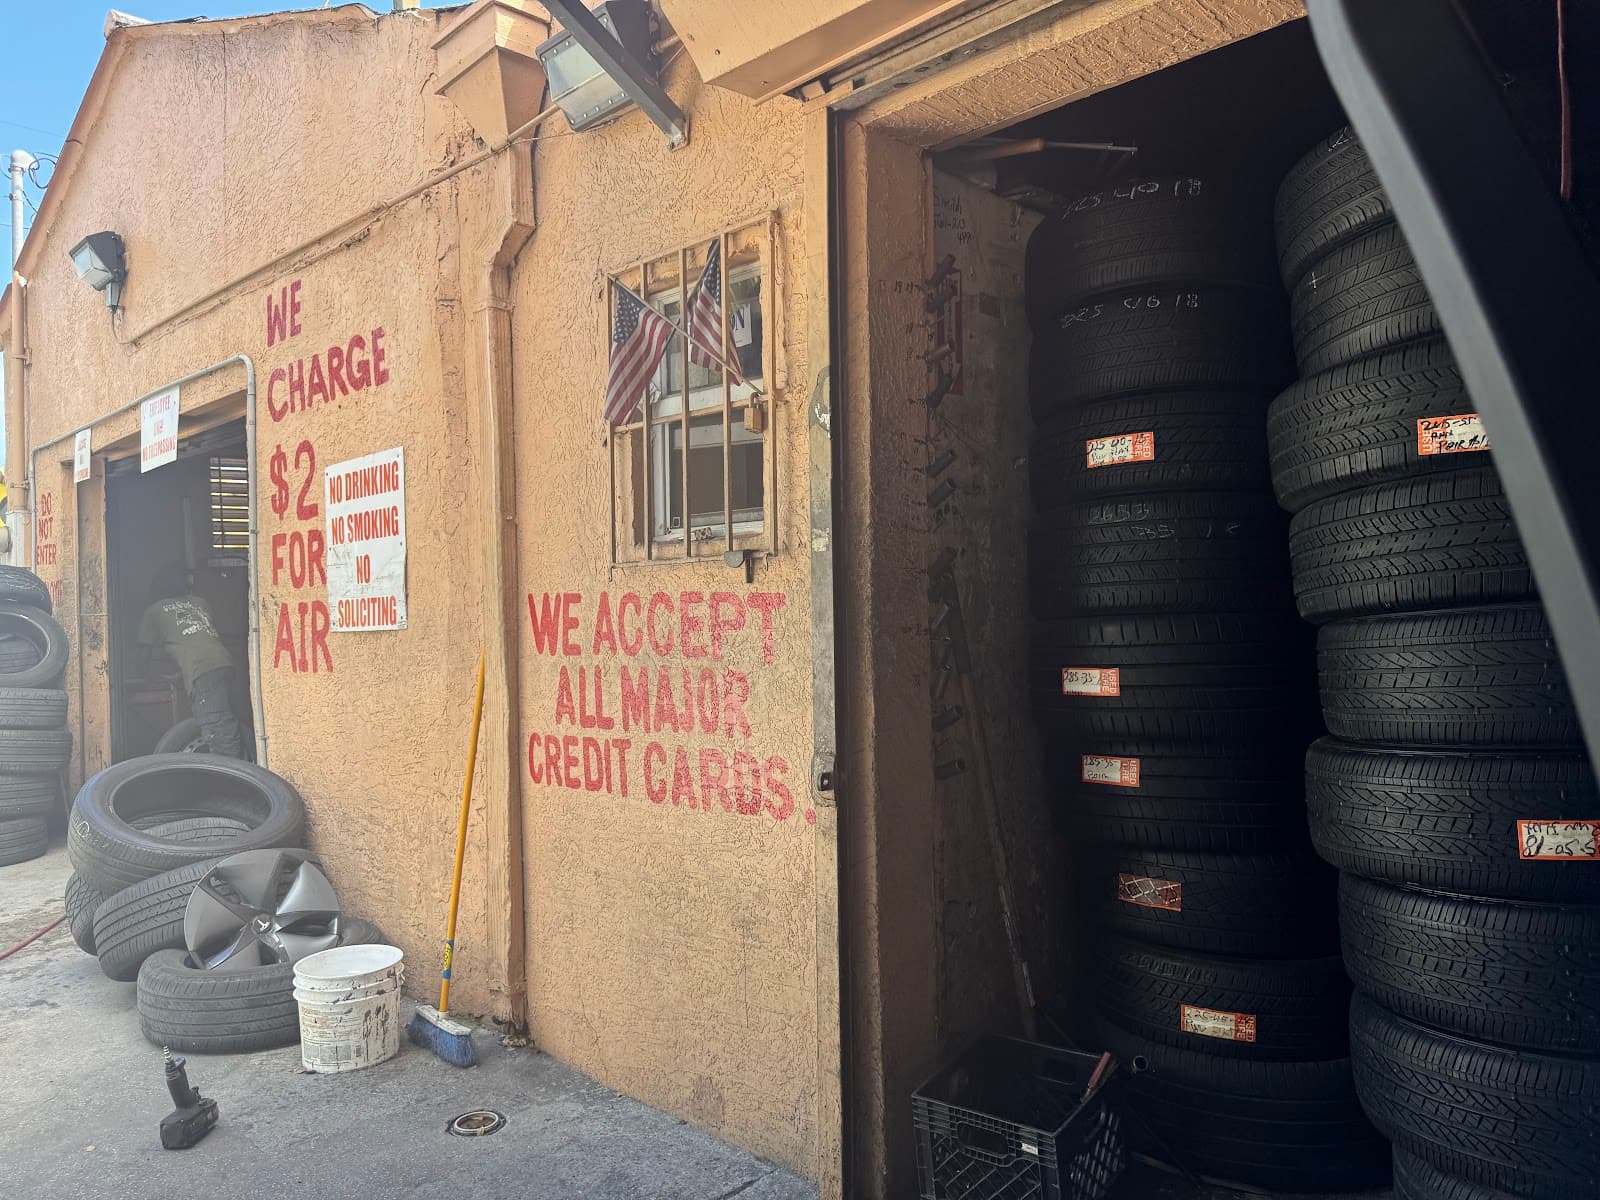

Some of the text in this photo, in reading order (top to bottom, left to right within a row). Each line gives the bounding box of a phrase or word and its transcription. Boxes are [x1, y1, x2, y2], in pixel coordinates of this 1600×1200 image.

[267, 279, 301, 348] WE
[267, 326, 390, 422] CHARGE
[41, 492, 52, 516] DO
[270, 439, 319, 521] $2
[329, 460, 399, 504] NO DRINKING
[37, 543, 56, 566] ENTER
[38, 517, 53, 540] NOT
[331, 505, 400, 545] NO SMOKING
[272, 529, 327, 589] FOR
[356, 554, 371, 585] NO
[273, 600, 333, 673] AIR
[337, 595, 397, 628] SOLICITING
[528, 591, 787, 664] WE ACCEPT
[555, 665, 752, 739] ALL MAJOR
[528, 732, 632, 797] CREDIT
